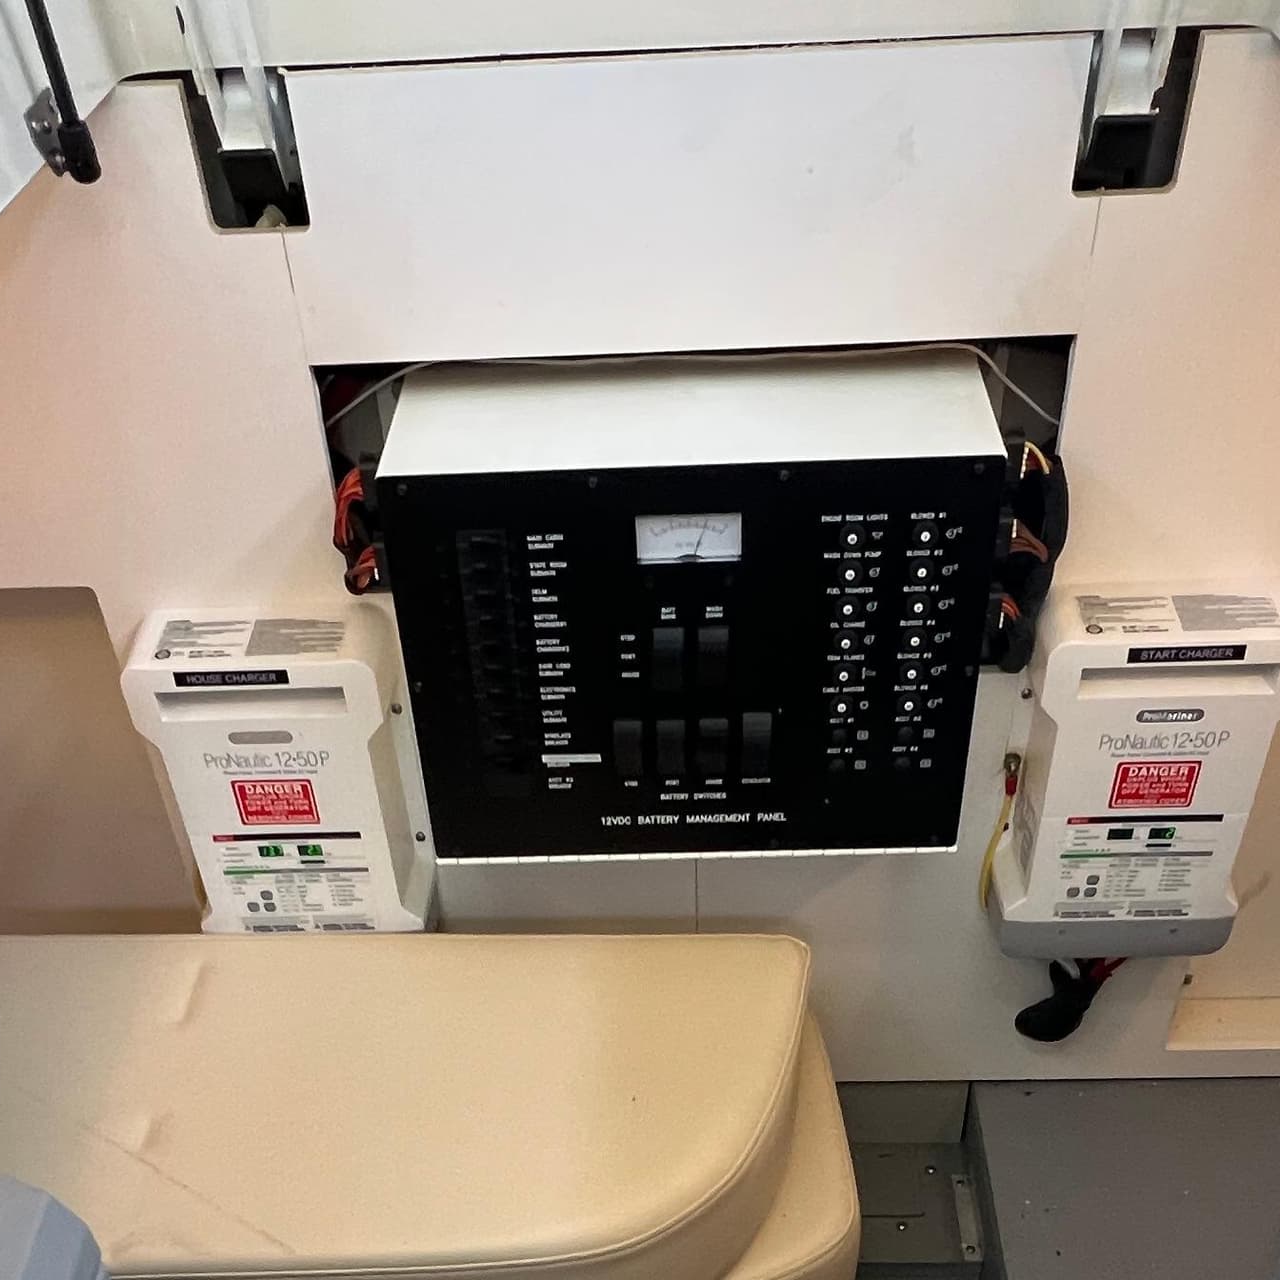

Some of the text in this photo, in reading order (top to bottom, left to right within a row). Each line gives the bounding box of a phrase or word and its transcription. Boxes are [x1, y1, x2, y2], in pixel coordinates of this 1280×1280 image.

[1140, 648, 1233, 660] START CHARGER
[186, 672, 277, 684] HOUSE CHARGER
[1099, 734, 1169, 750] ProNautic
[202, 752, 273, 769] ProNautic
[1128, 766, 1189, 777] DANGER
[245, 783, 303, 794] DANGER
[601, 811, 787, 826] 12VDC BATTERY MANAGEMENT PANEL
